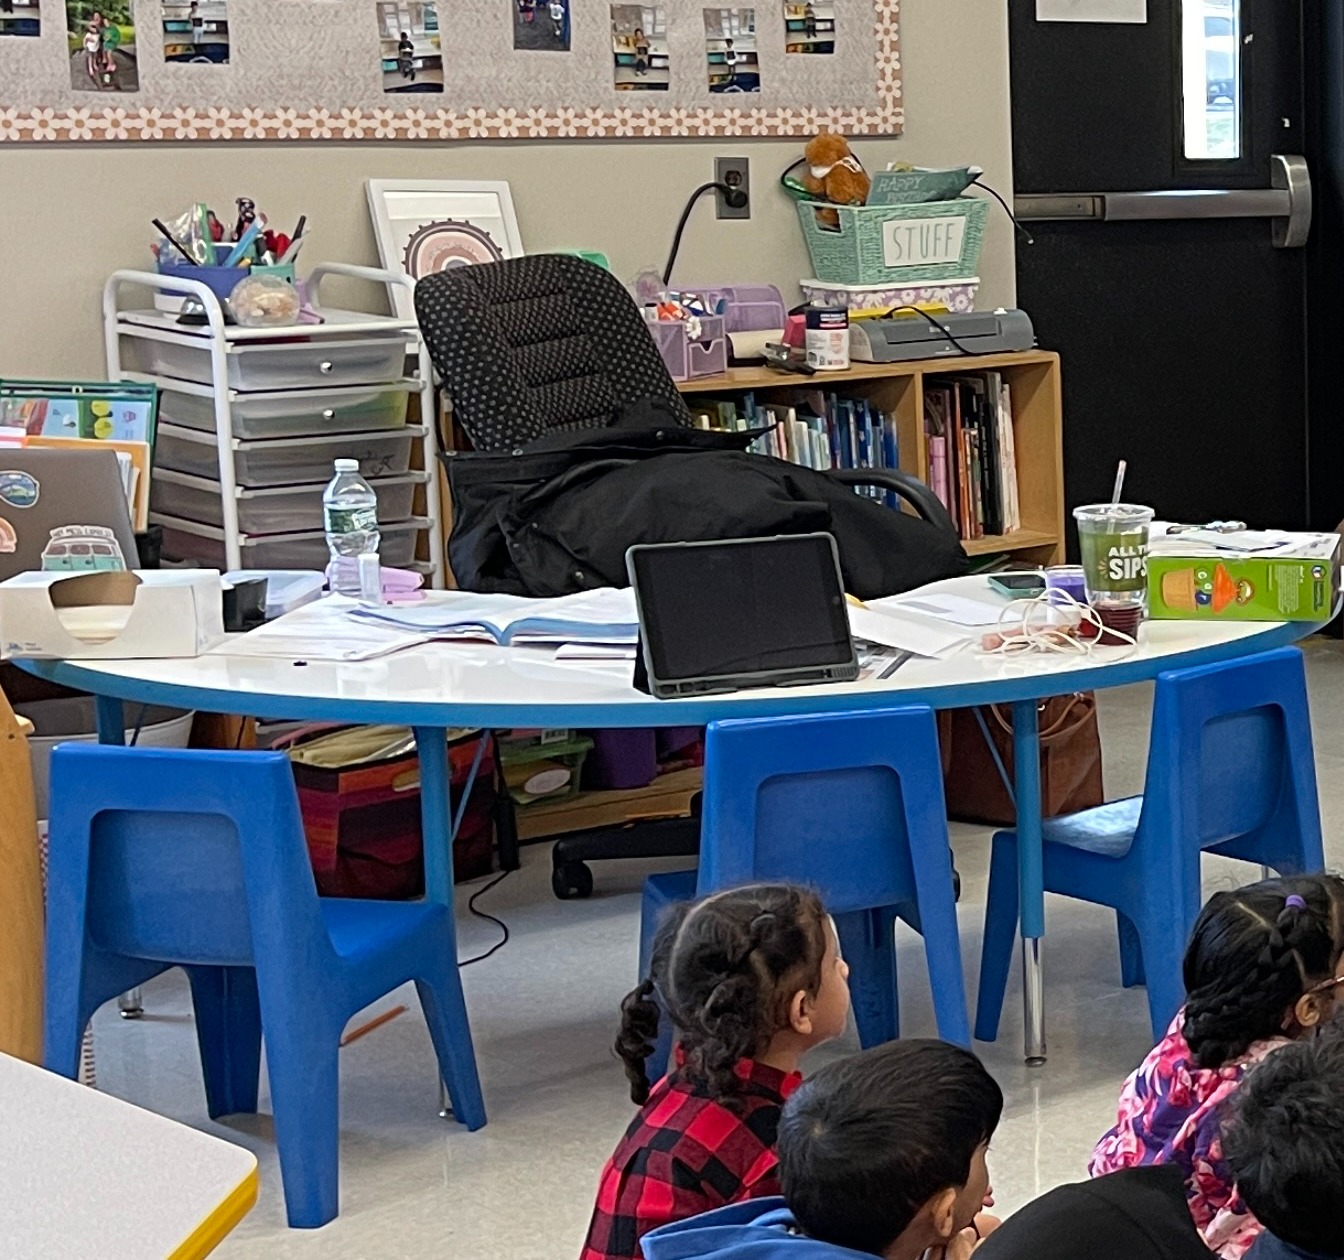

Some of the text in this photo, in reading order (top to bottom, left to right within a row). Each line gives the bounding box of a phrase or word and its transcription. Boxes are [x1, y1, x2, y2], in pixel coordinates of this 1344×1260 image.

[877, 176, 925, 191] HAPPY
[893, 223, 954, 260] STUFF
[1108, 547, 1138, 557] ALL
[1109, 558, 1147, 580] SIPS
